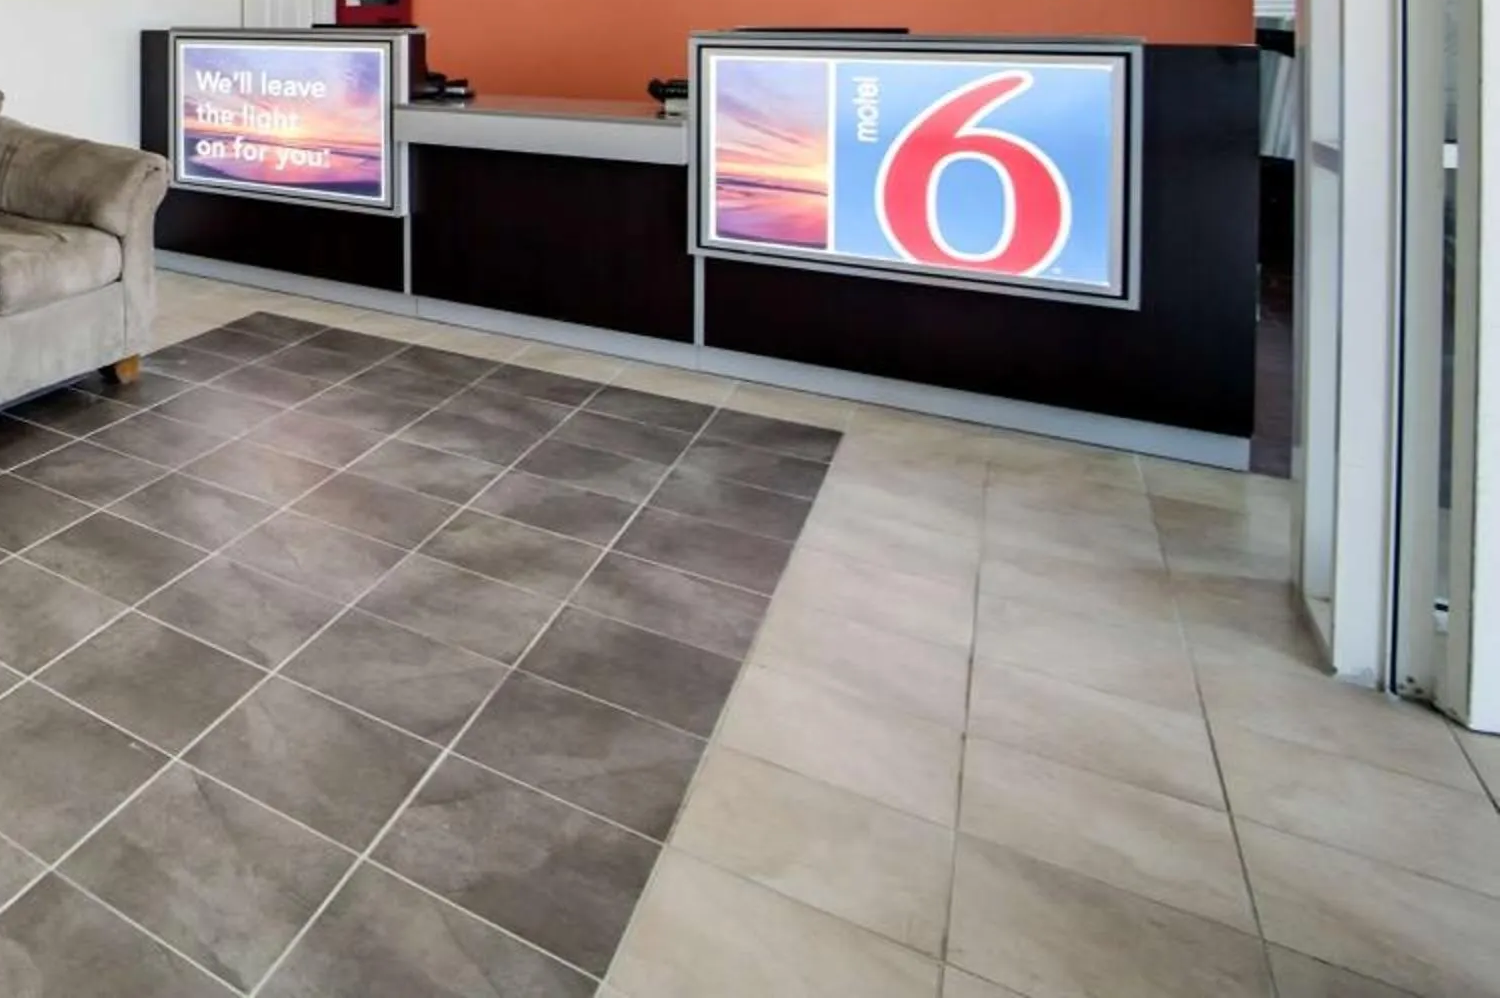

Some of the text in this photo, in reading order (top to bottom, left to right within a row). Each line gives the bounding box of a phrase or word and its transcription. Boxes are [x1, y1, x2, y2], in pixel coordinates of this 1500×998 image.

[196, 69, 327, 97] We'll leave
[196, 103, 300, 133] the light
[195, 139, 225, 158] on
[232, 136, 270, 162] for
[852, 69, 1072, 277] motel 6
